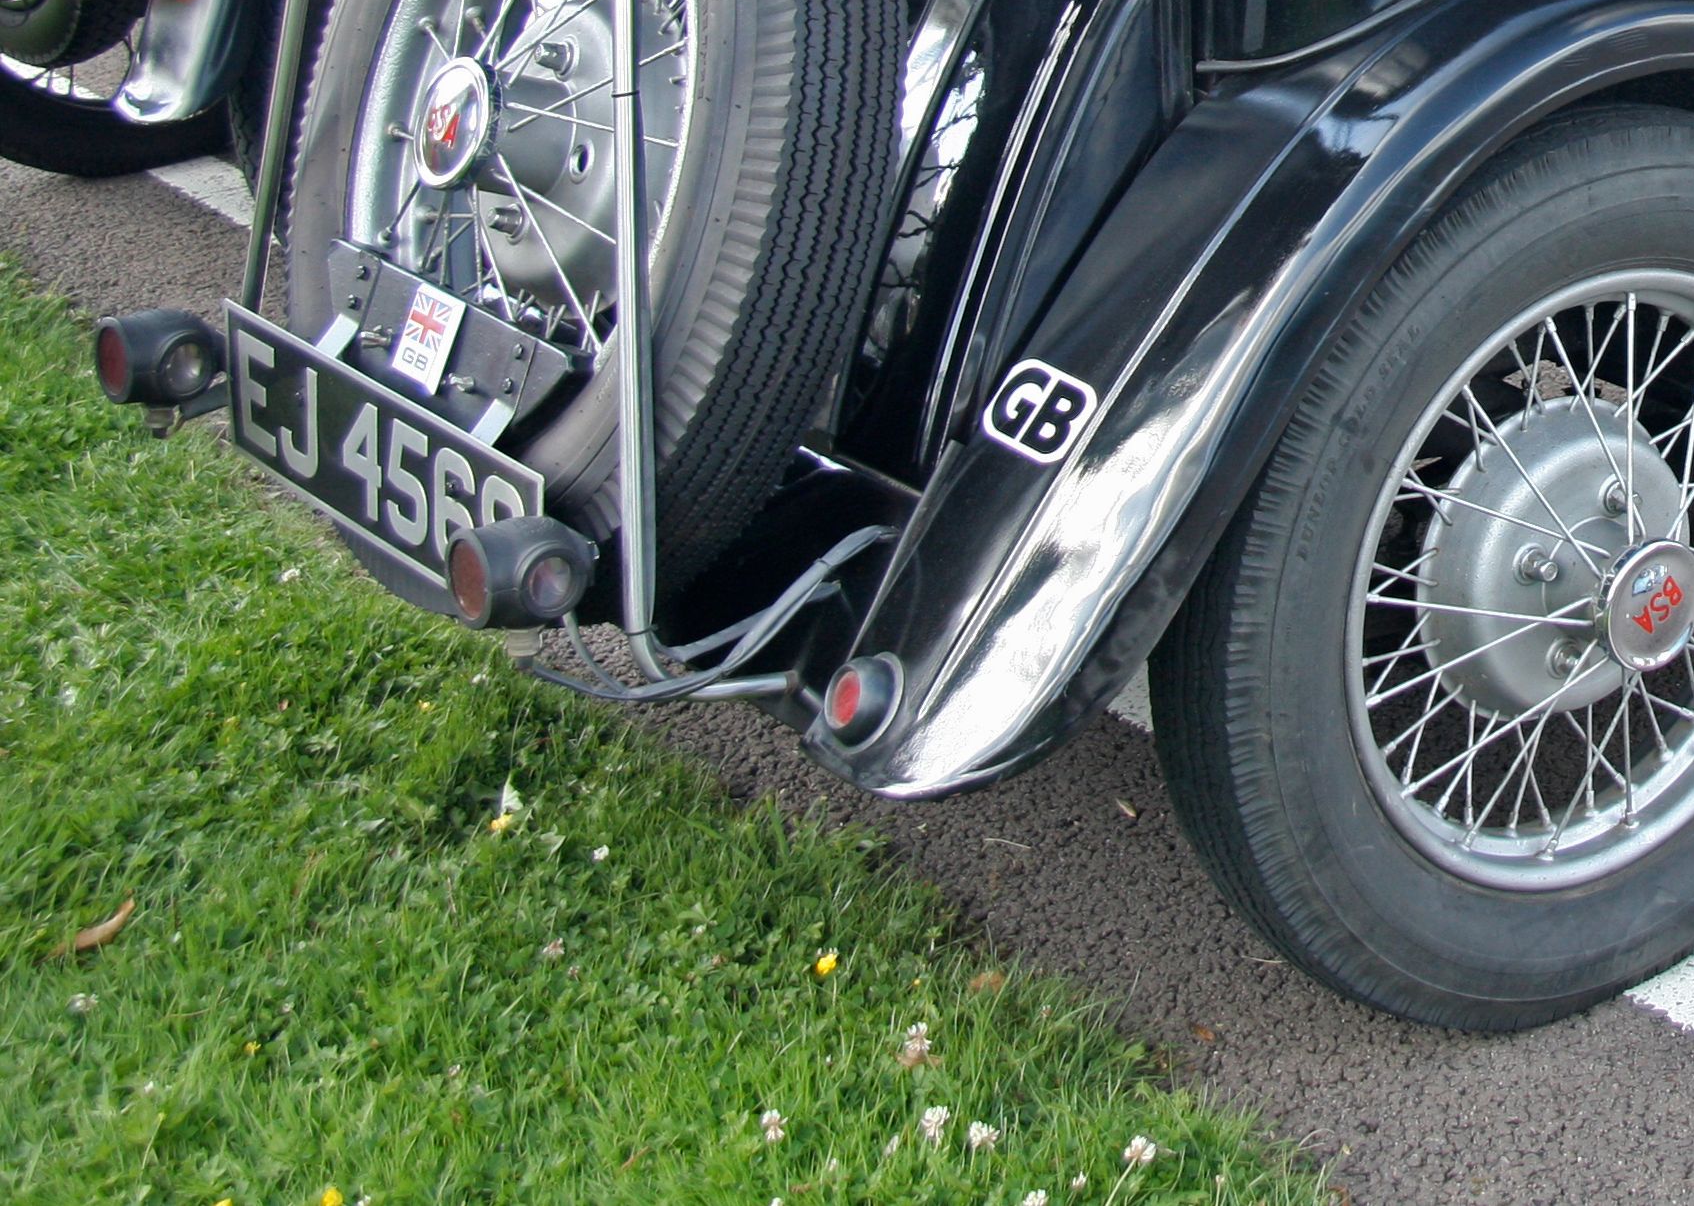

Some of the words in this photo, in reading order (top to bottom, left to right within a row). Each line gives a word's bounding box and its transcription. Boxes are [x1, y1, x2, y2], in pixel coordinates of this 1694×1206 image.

[401, 346, 429, 371] GB
[237, 328, 319, 479] EJ
[991, 367, 1088, 455] GB
[1296, 459, 1338, 562] DUNLOP
[1632, 575, 1684, 634] BSA
